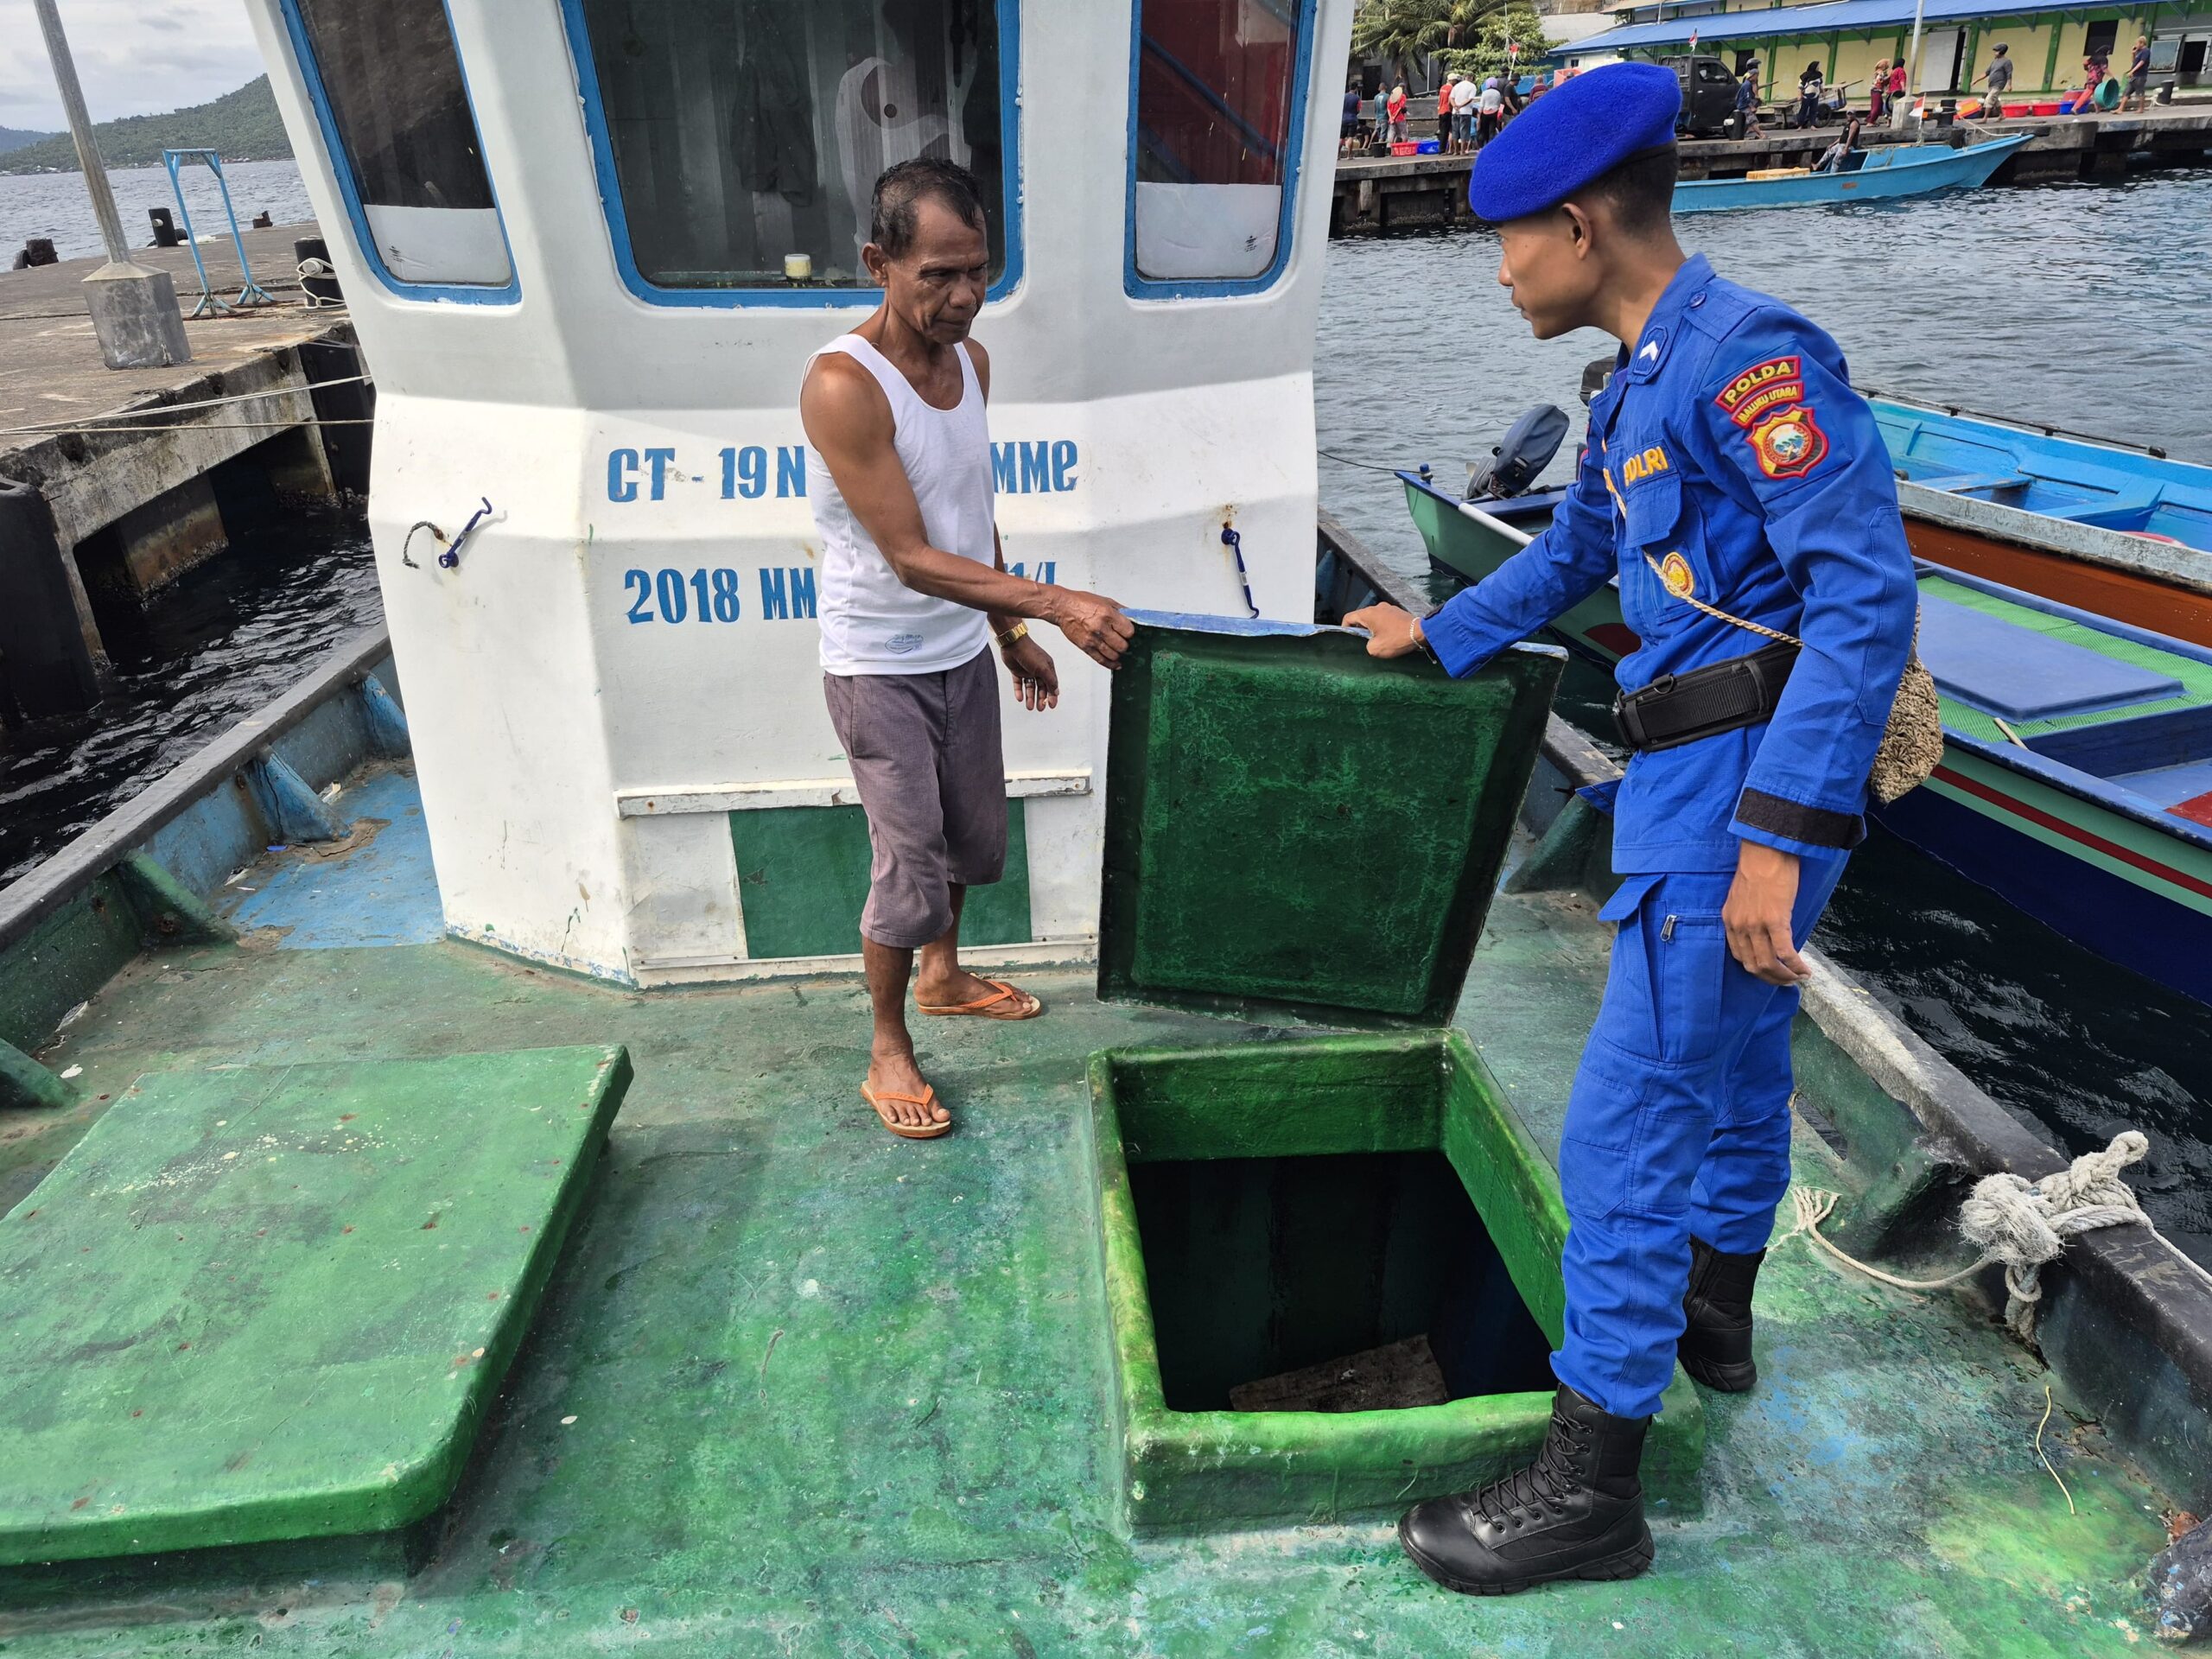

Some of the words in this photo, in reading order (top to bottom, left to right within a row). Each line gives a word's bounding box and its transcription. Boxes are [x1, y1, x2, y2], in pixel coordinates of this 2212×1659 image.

[1725, 361, 1791, 404] POLDA
[1769, 385, 1797, 400] UTARA
[625, 568, 741, 624] 2018
